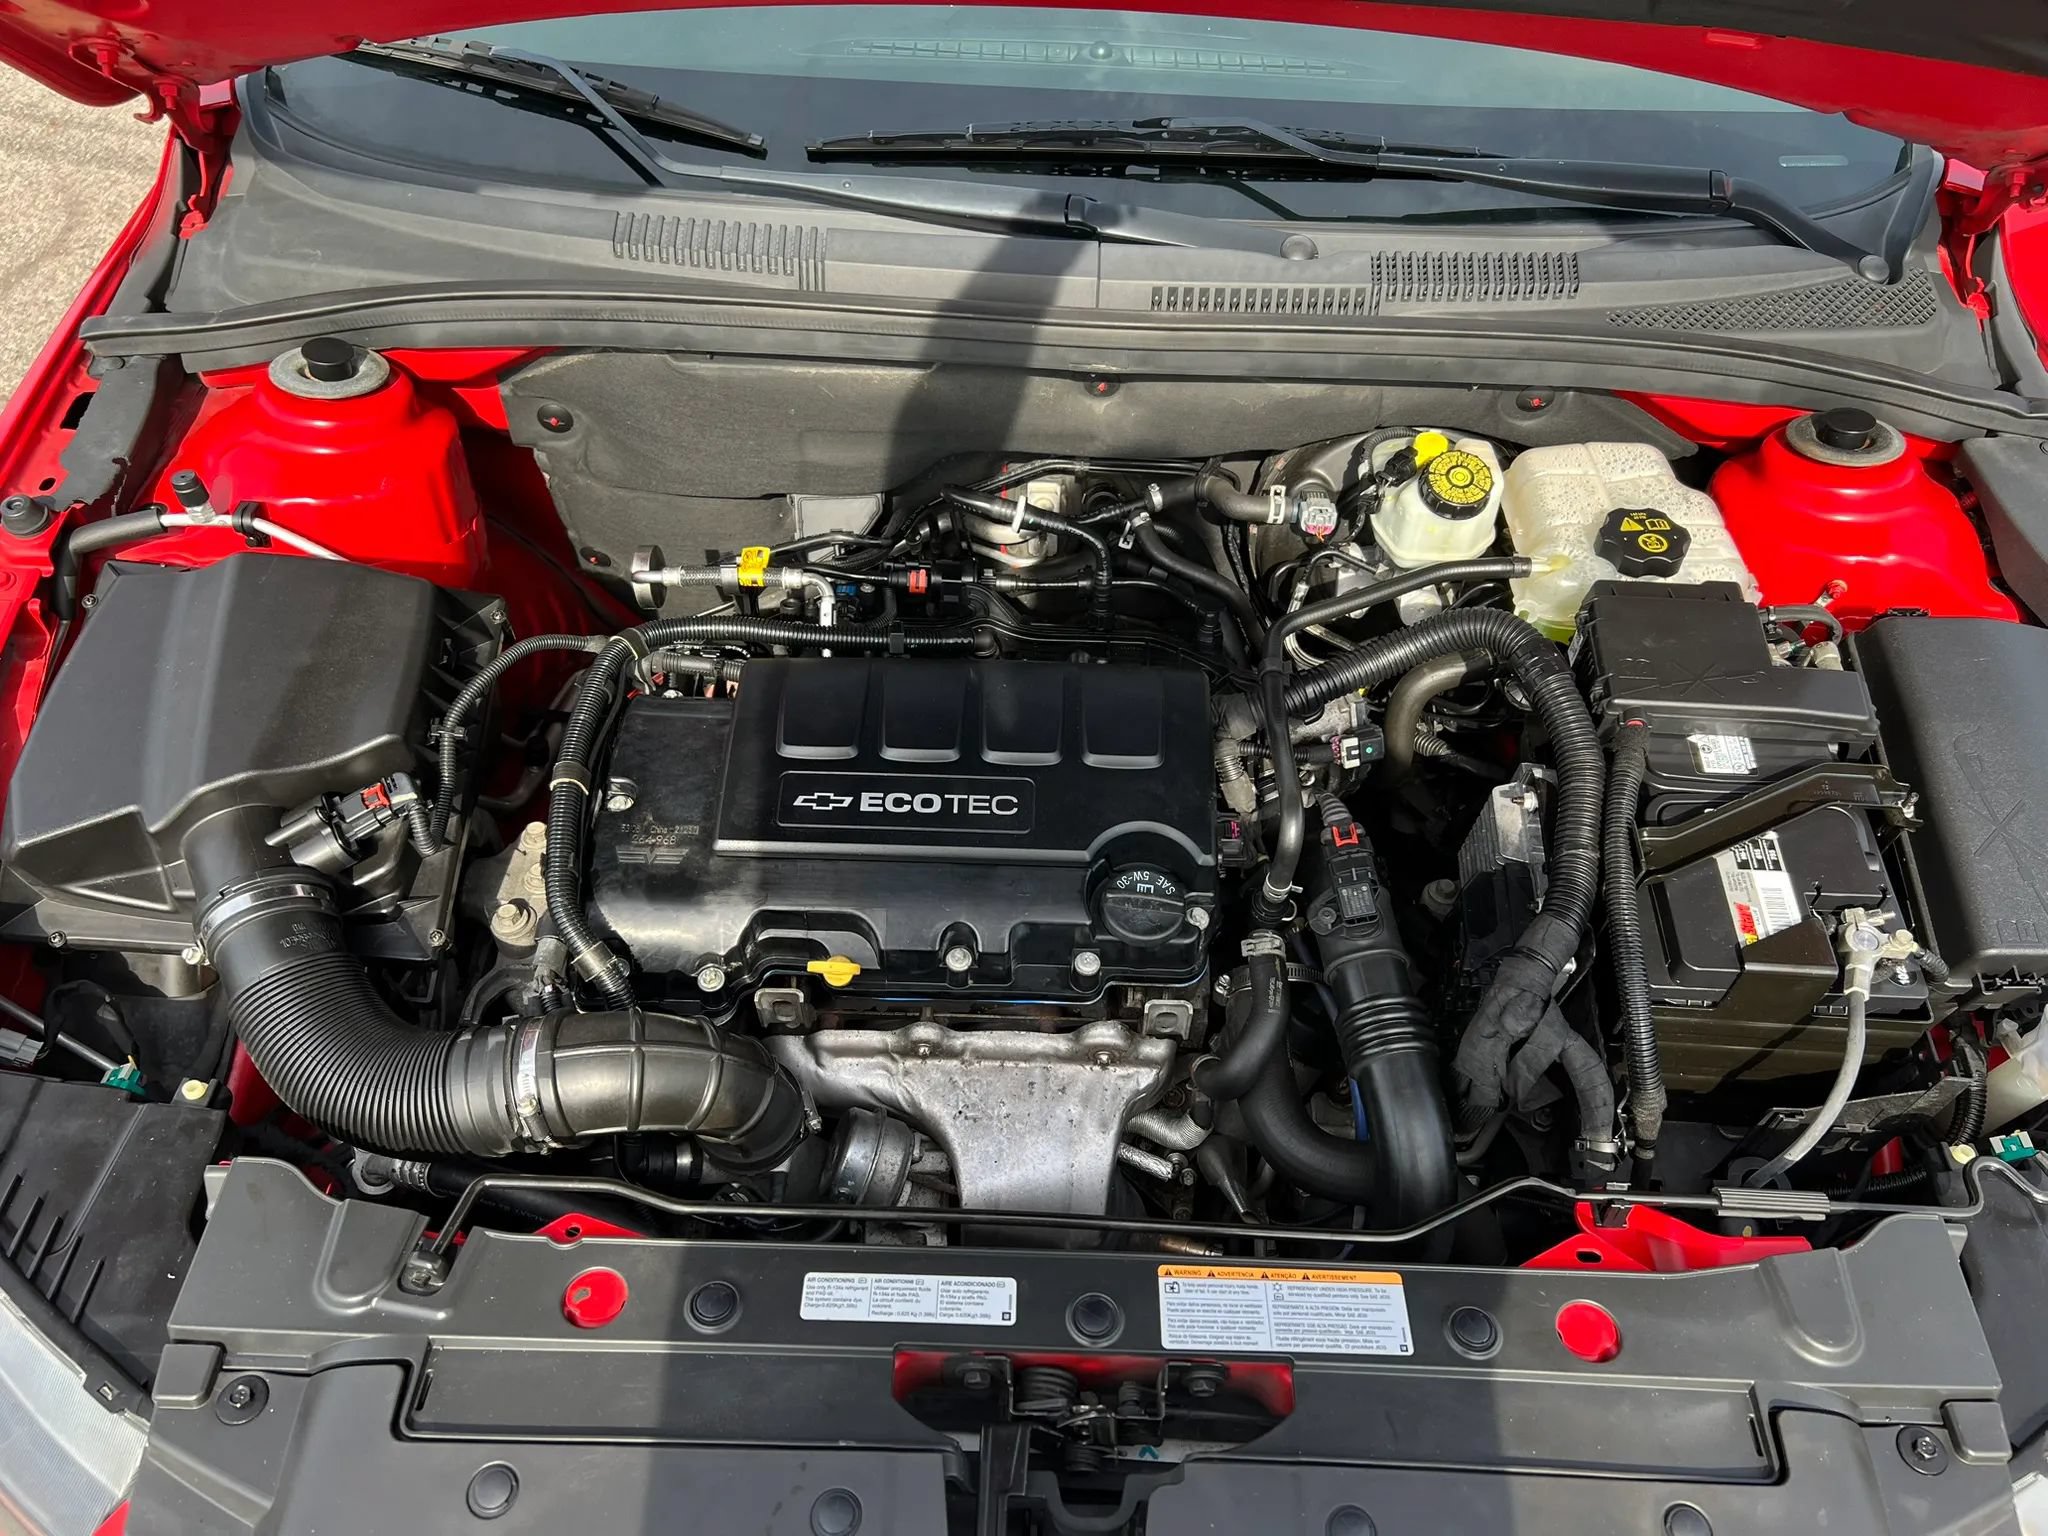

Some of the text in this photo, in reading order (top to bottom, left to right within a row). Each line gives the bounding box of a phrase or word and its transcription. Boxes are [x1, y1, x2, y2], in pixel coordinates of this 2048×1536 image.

[860, 792, 1020, 816] ECOTEC
[1116, 871, 1176, 895] SAE 5W-30
[1271, 1272, 1296, 1280] ATENÇÃO
